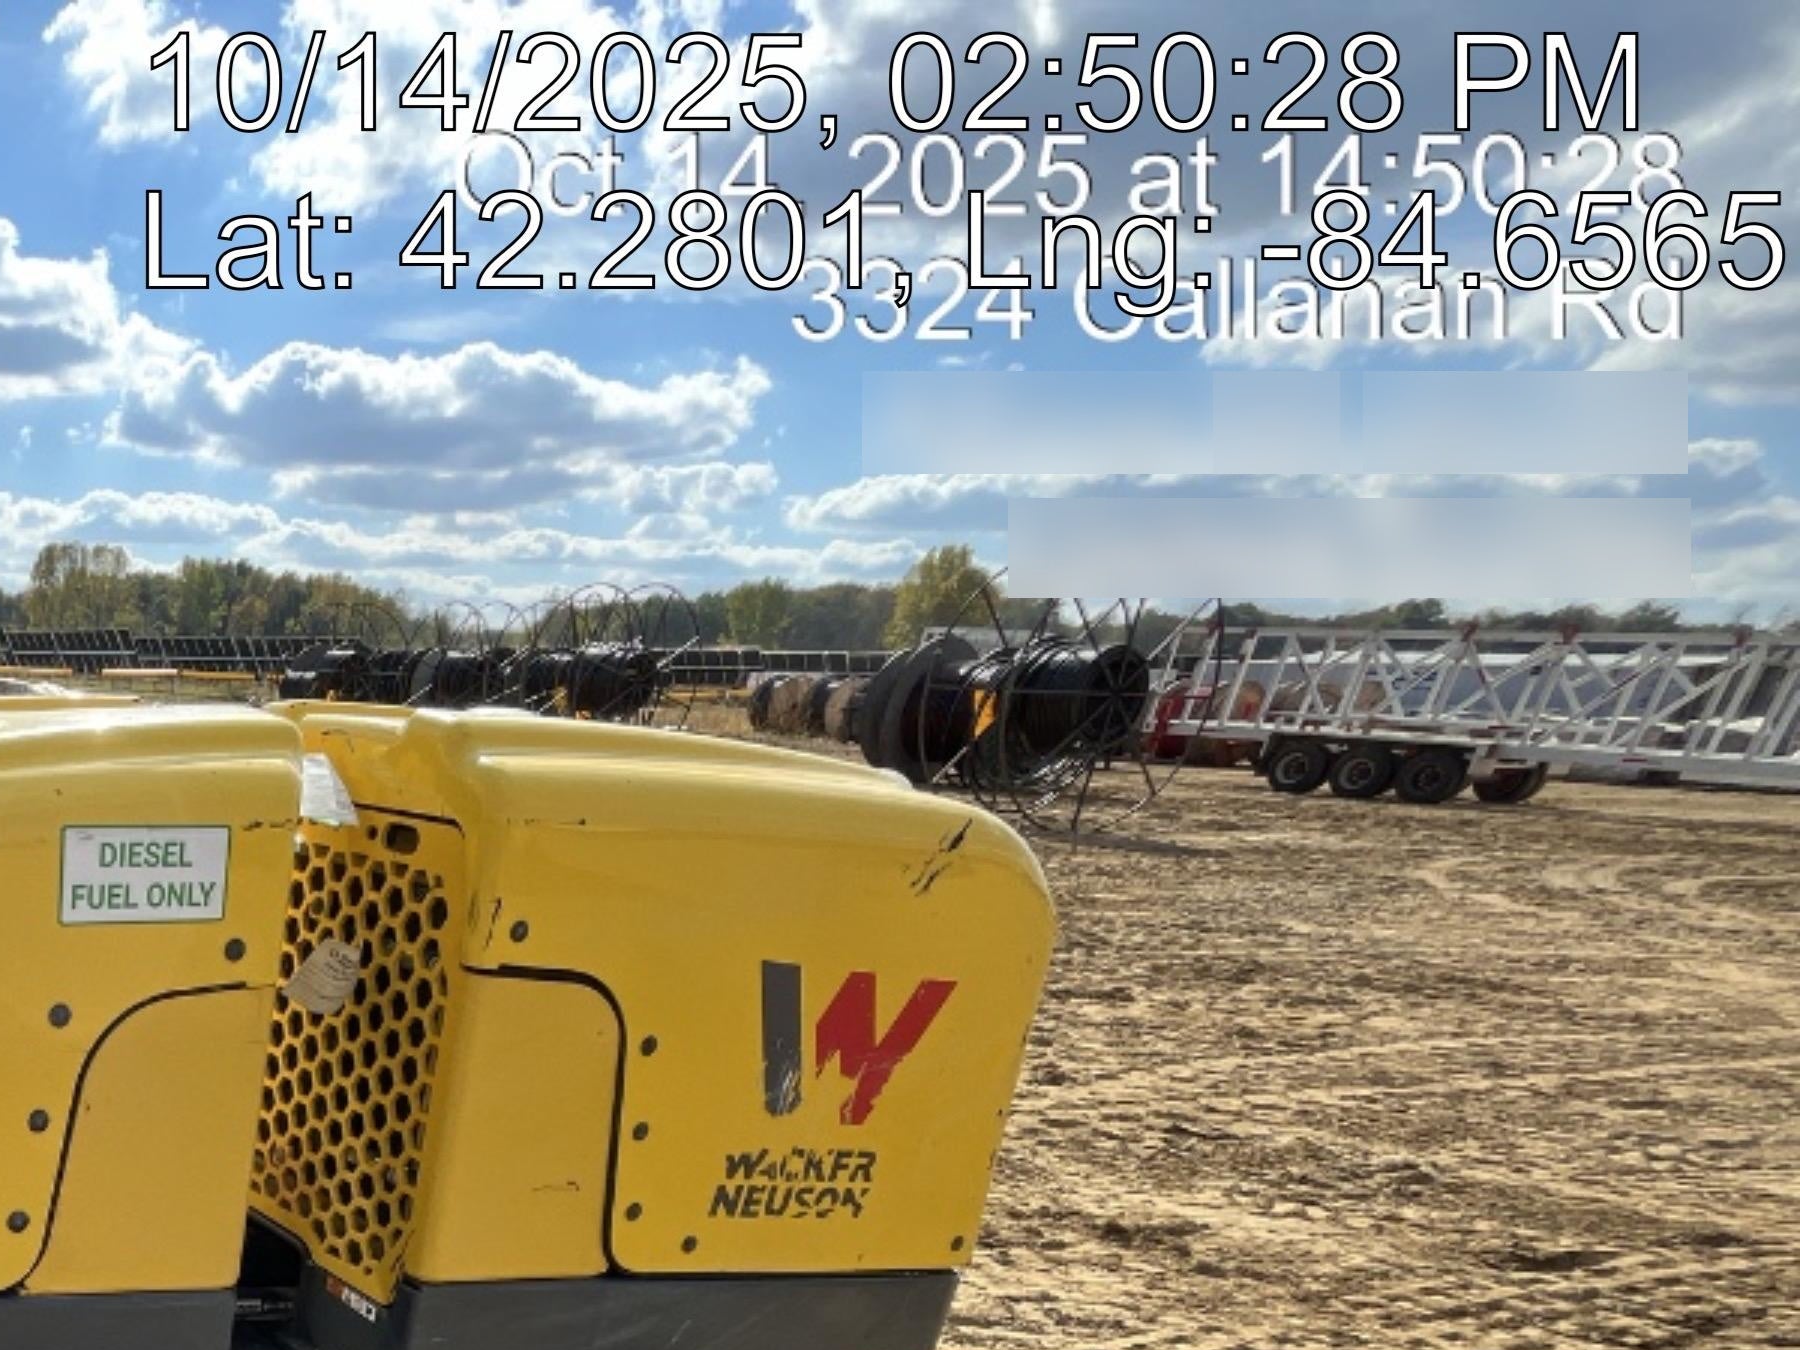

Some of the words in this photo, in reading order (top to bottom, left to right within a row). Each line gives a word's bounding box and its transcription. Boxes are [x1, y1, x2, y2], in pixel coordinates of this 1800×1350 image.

[98, 841, 193, 868] DIESEL
[71, 883, 139, 910] FUEL
[146, 881, 217, 908] ONLY
